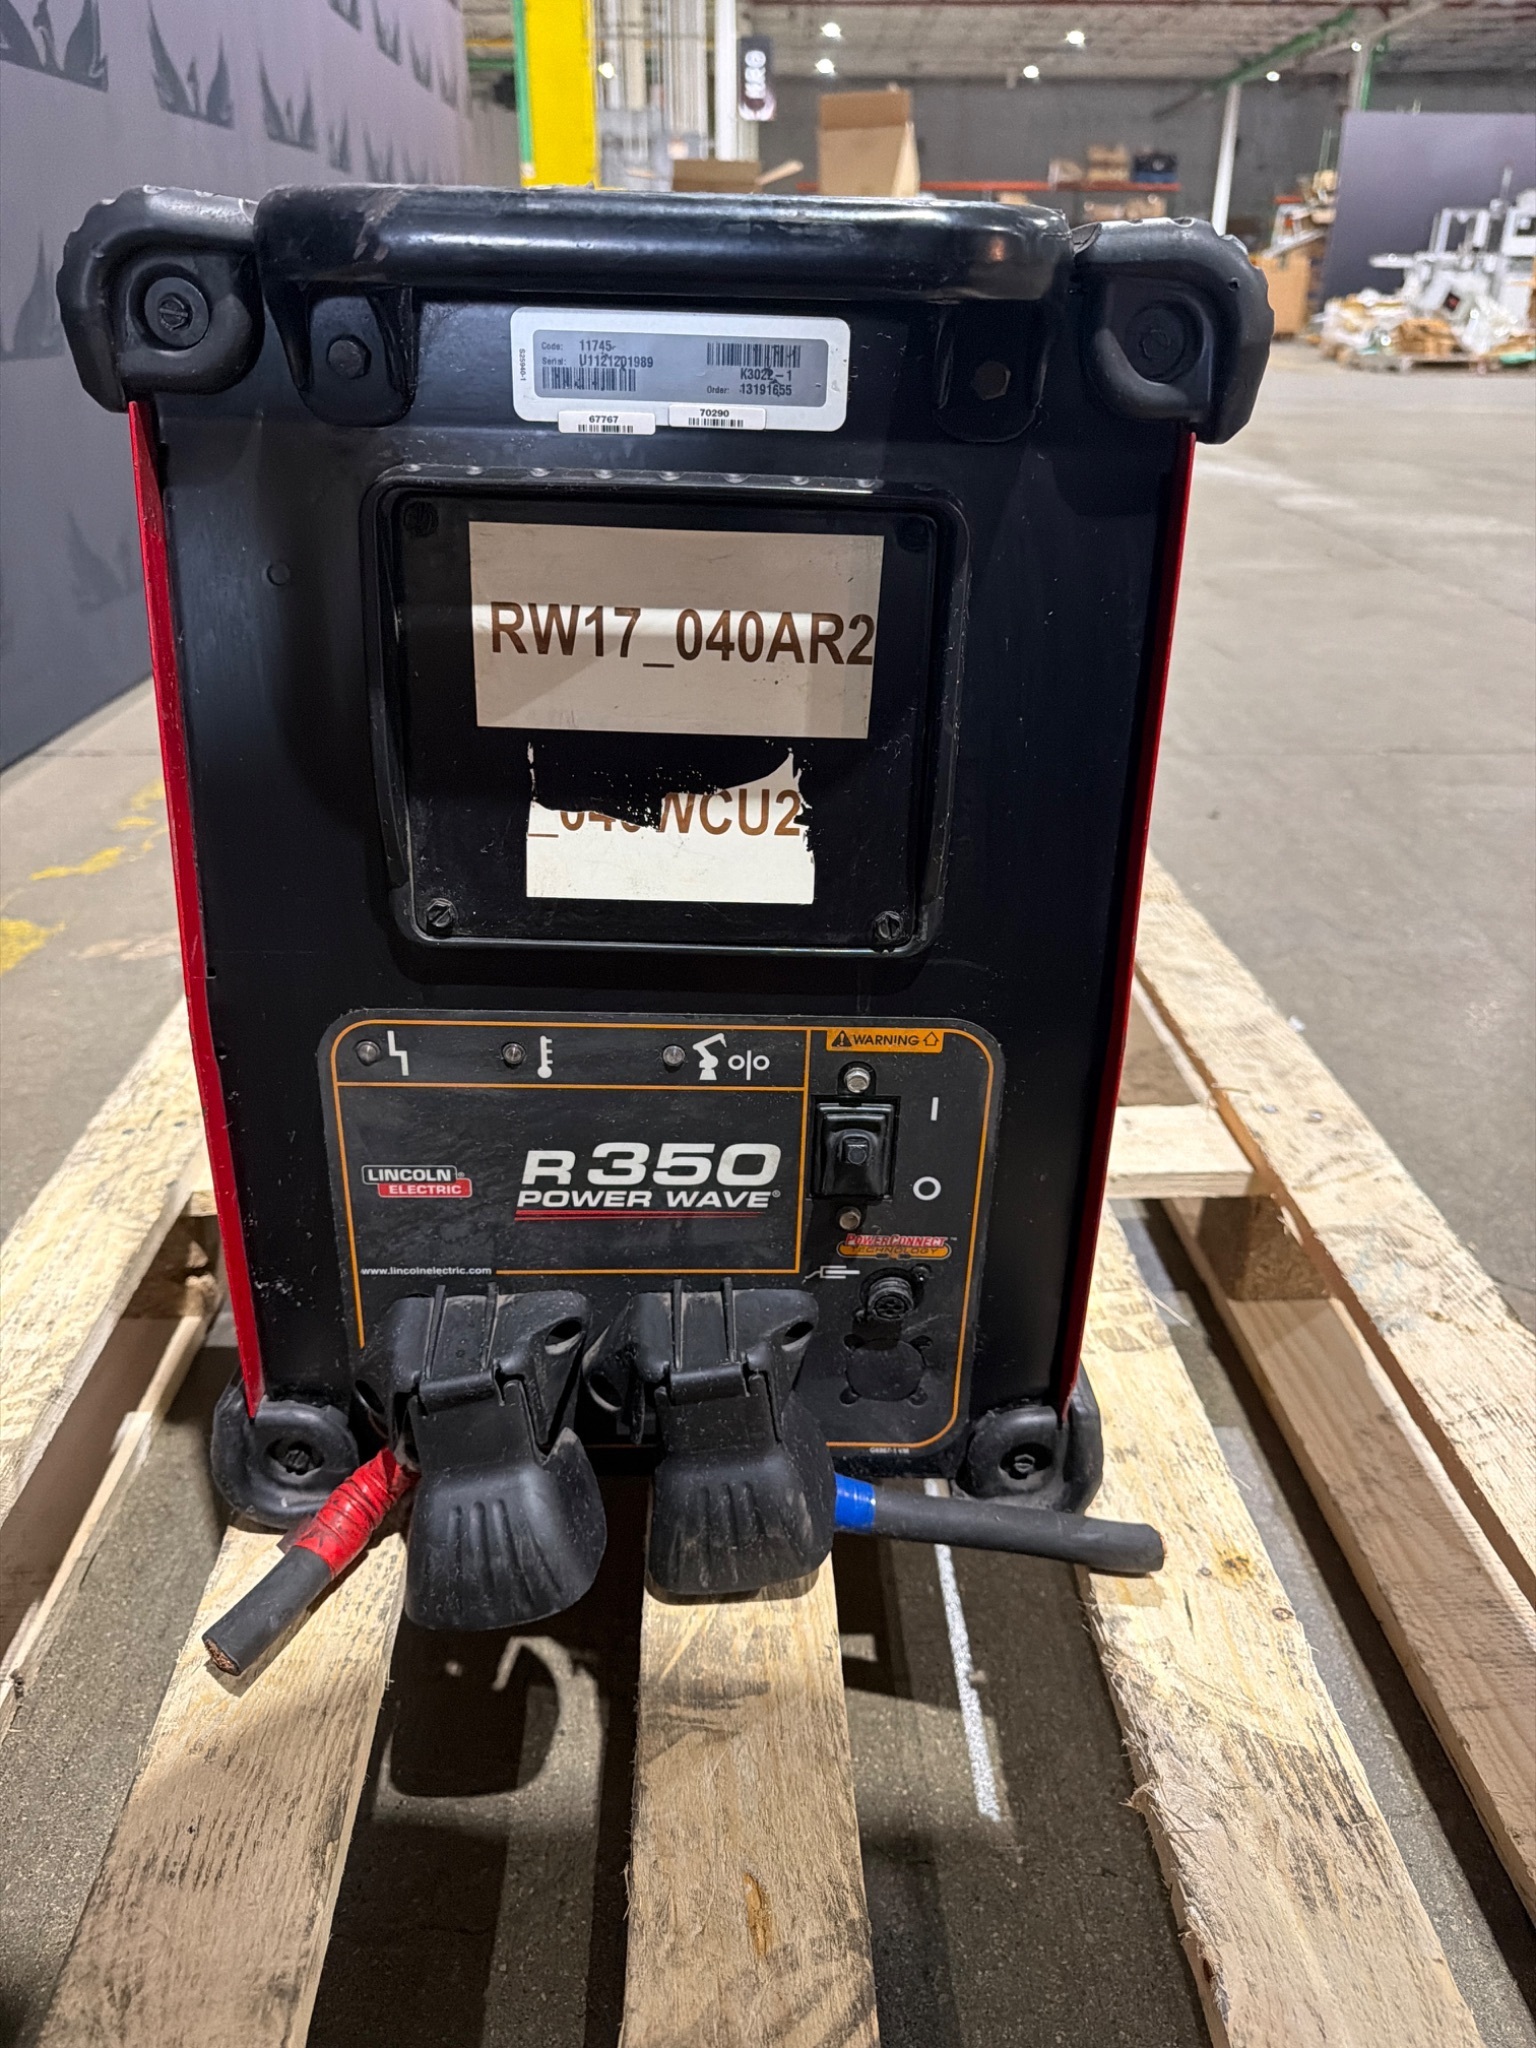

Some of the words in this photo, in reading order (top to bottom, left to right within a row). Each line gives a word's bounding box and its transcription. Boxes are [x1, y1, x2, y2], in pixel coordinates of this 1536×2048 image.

[541, 341, 563, 352] Code:
[579, 339, 613, 352] 11745
[542, 356, 567, 367] Serial:
[579, 355, 654, 369] U1121201989
[588, 415, 619, 424] 67767
[699, 408, 730, 418] 70290
[490, 600, 875, 668] RW17_040AR2
[527, 788, 801, 837] _WCU2
[853, 1033, 919, 1047] WARNING
[521, 1150, 576, 1185] R
[587, 1142, 782, 1187] 350
[367, 1169, 452, 1182] LINCOLN
[388, 1184, 462, 1195] ELECTRIC
[516, 1190, 653, 1208] POWER
[666, 1190, 771, 1208] WAVE
[360, 1266, 492, 1276] www.lincolnelectric.com
